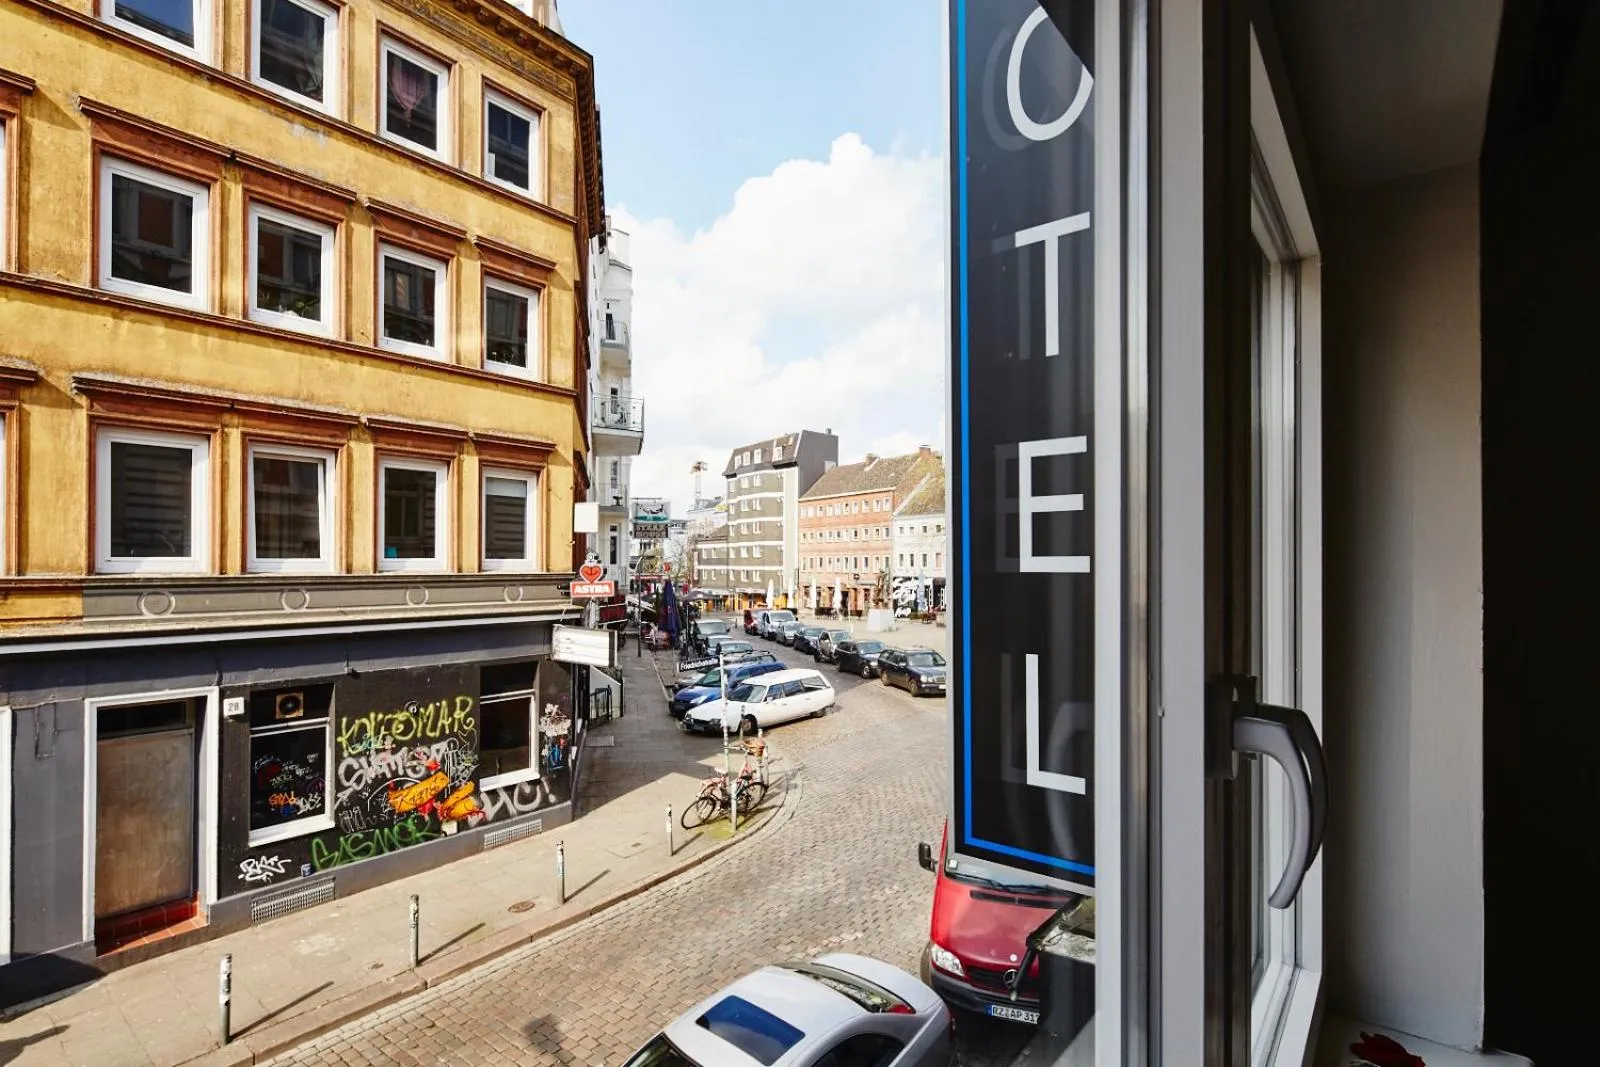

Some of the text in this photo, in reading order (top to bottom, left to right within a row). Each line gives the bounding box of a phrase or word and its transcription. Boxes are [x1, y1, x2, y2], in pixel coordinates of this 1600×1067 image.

[573, 585, 611, 594] ASTRA
[227, 702, 240, 712] 28
[993, 1006, 1005, 1017] RZ
[1010, 1009, 1023, 1019] AP
